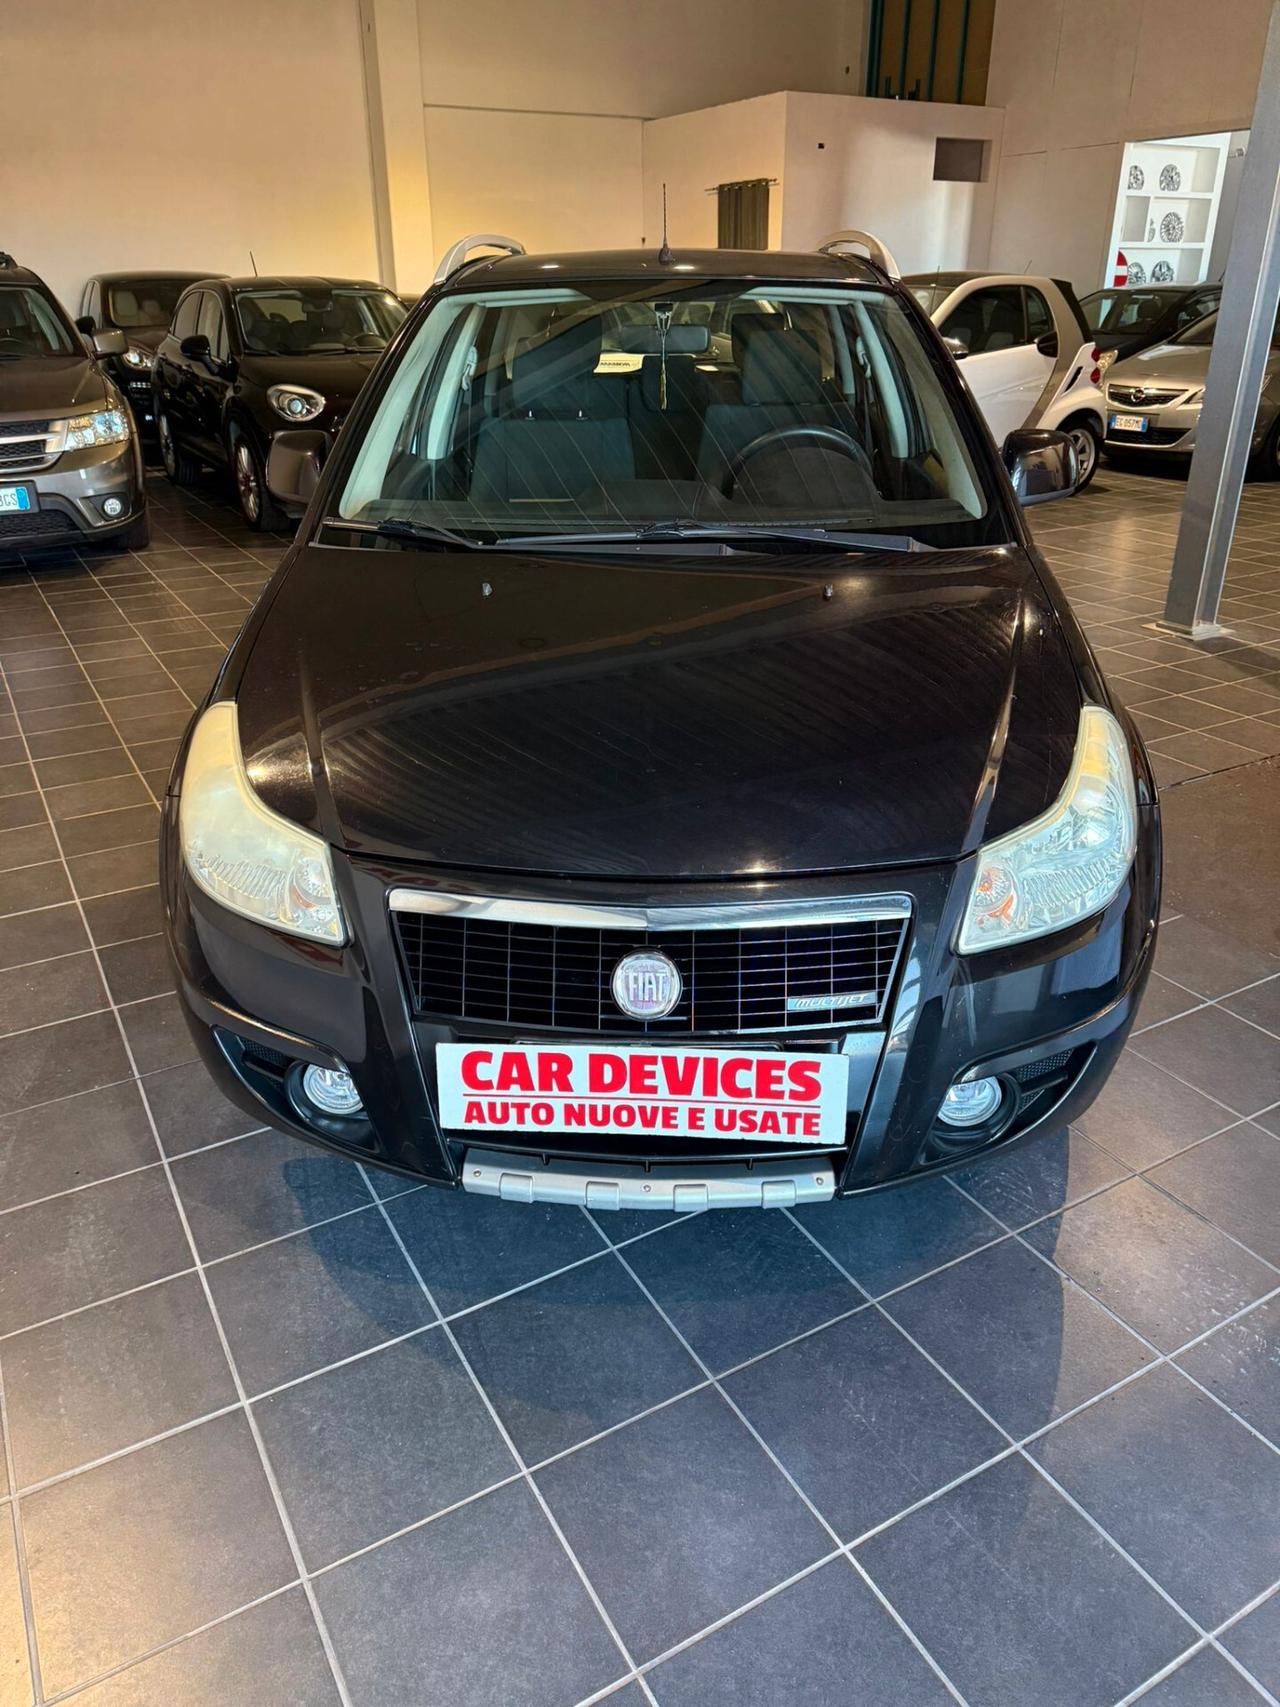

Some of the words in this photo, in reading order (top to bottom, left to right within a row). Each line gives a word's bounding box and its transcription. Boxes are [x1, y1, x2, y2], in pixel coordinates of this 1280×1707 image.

[626, 970, 666, 1001] FIAT
[461, 1051, 573, 1093] CAR
[588, 1054, 821, 1101] DEVICES
[464, 1102, 555, 1126] AUTO
[563, 1104, 678, 1130] NUOVE
[687, 1108, 705, 1131] E
[714, 1110, 820, 1136] USATE
